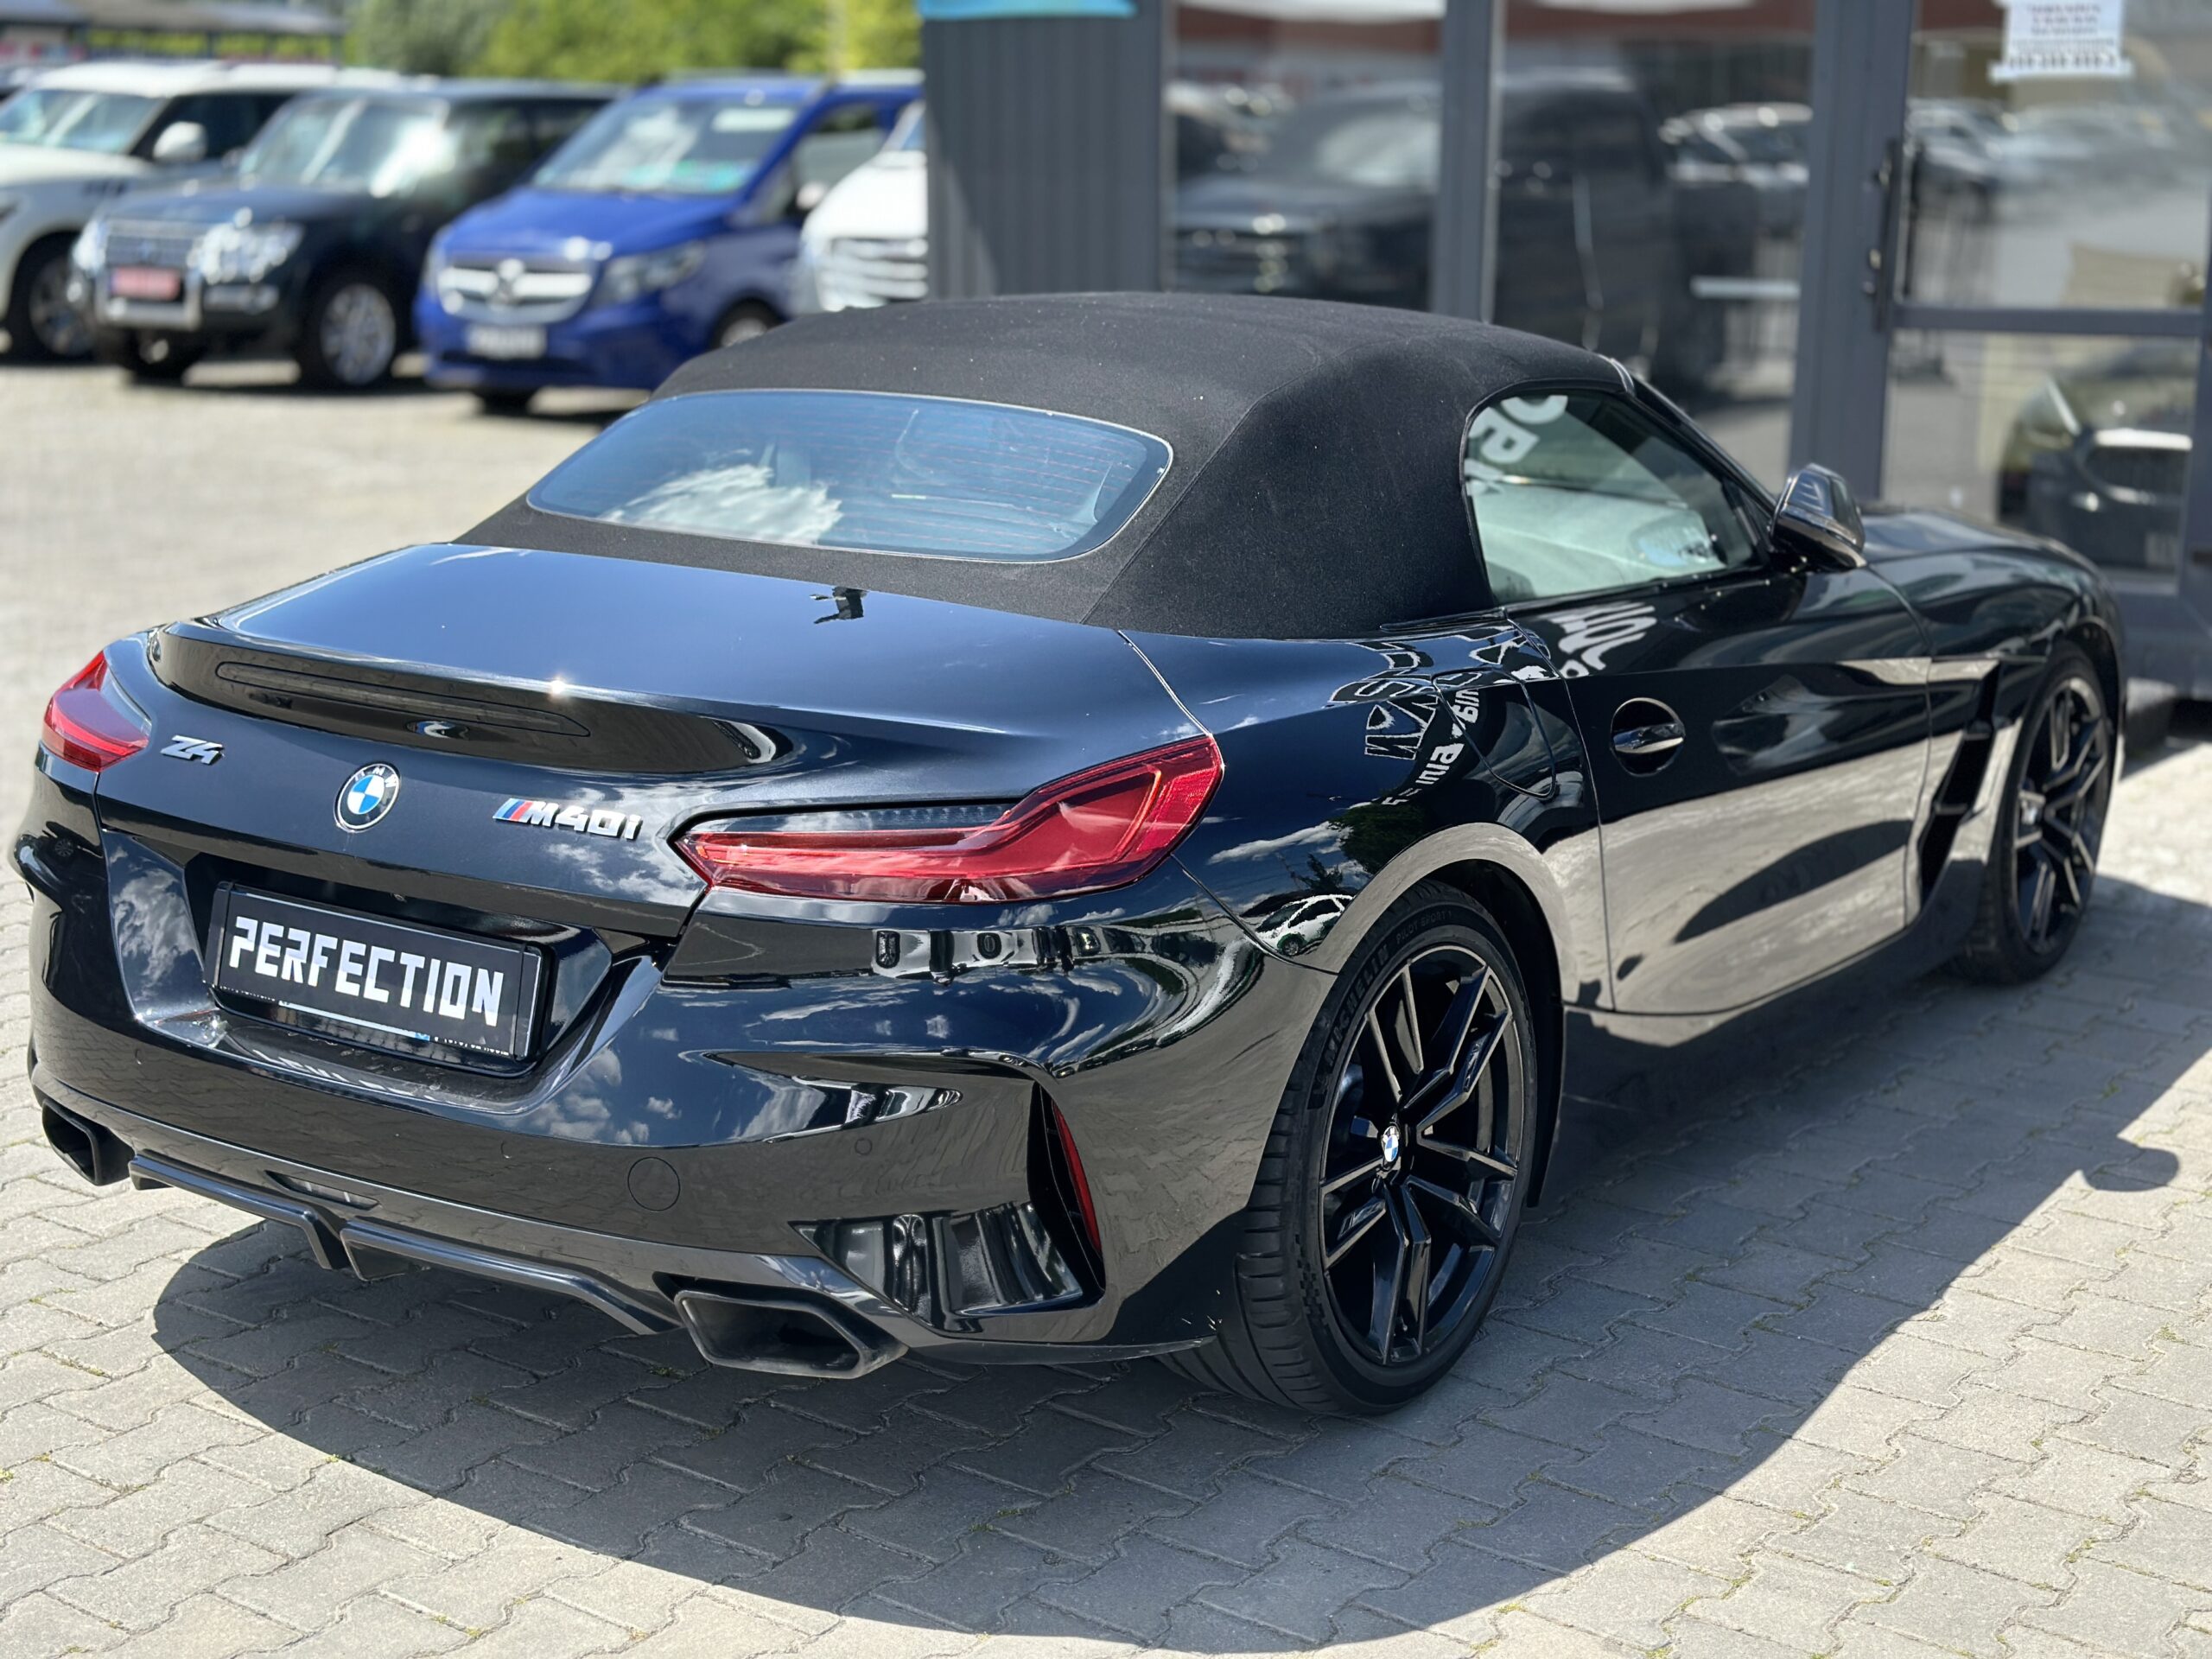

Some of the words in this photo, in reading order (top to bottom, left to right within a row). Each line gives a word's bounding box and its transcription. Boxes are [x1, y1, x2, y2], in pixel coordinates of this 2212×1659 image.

[160, 734, 223, 765] Z4
[518, 800, 641, 840] M40i
[1396, 919, 1419, 944] PILOT
[229, 916, 504, 1027] PERFECTION
[1325, 944, 1390, 1068] MICHELIN
